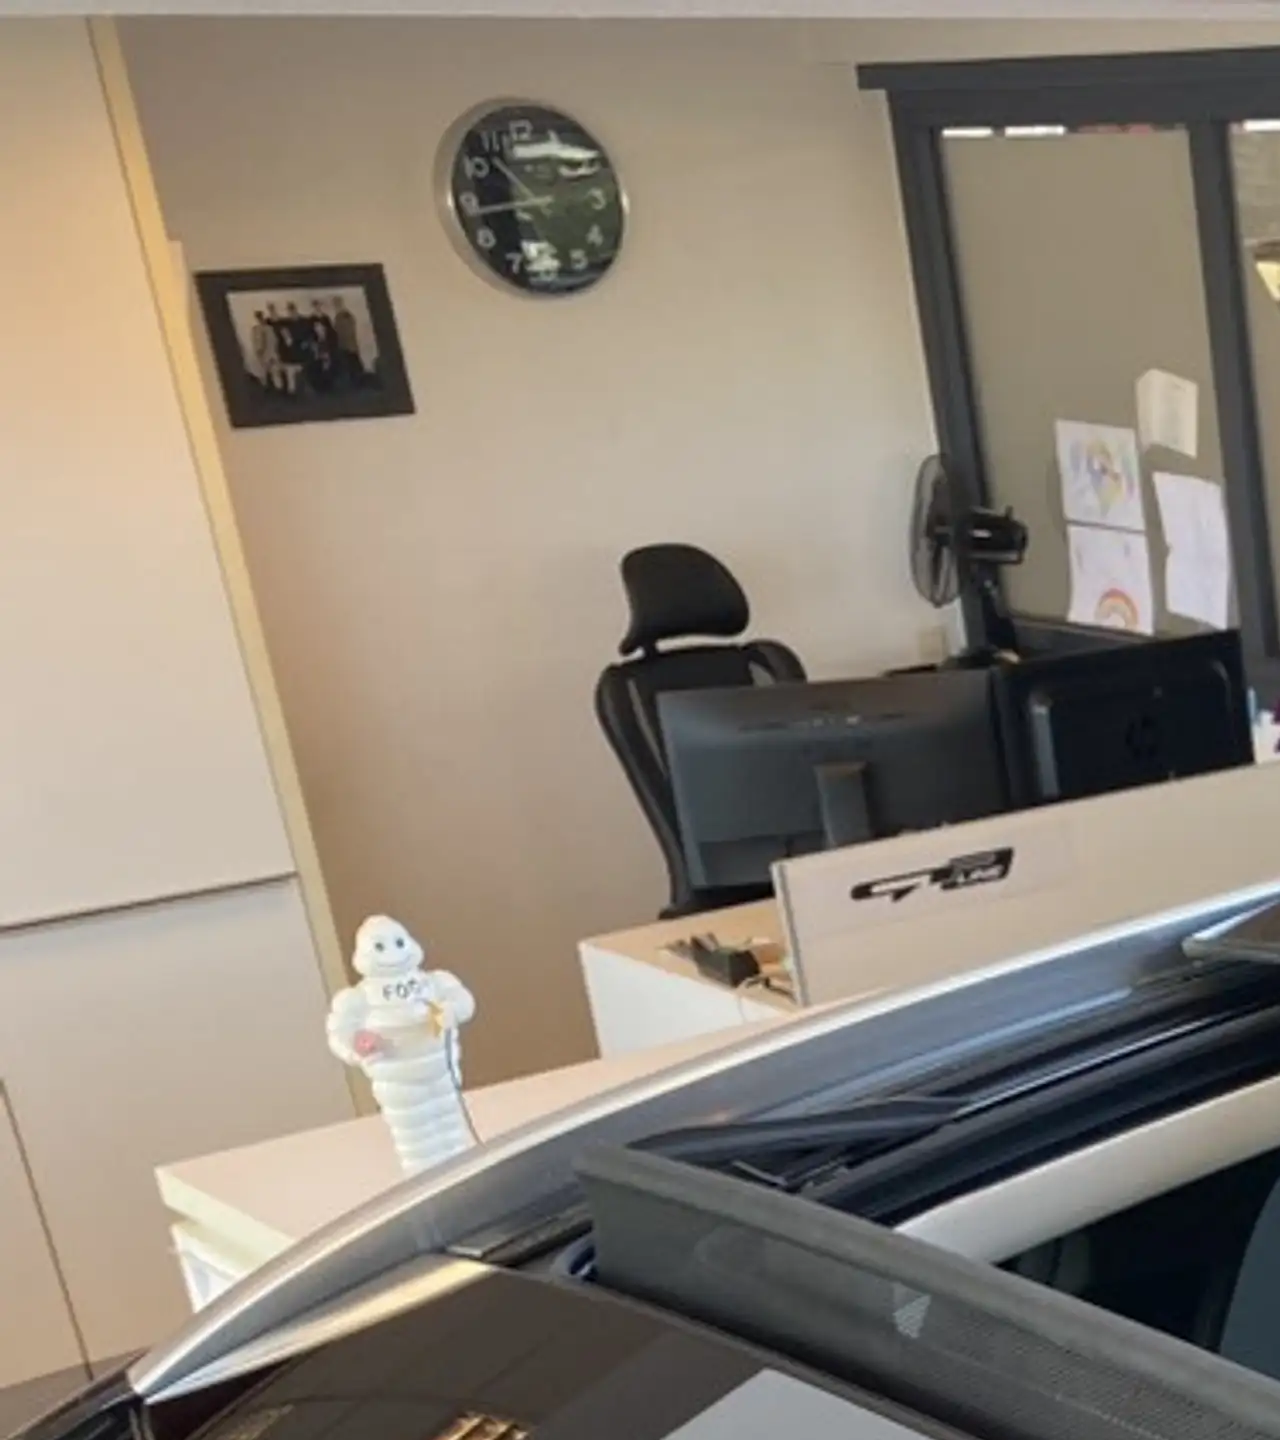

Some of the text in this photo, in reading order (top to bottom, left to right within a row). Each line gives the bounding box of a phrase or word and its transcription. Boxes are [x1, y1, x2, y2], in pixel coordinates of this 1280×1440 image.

[464, 155, 490, 179] 10
[587, 189, 607, 210] 3
[505, 252, 523, 275] 7
